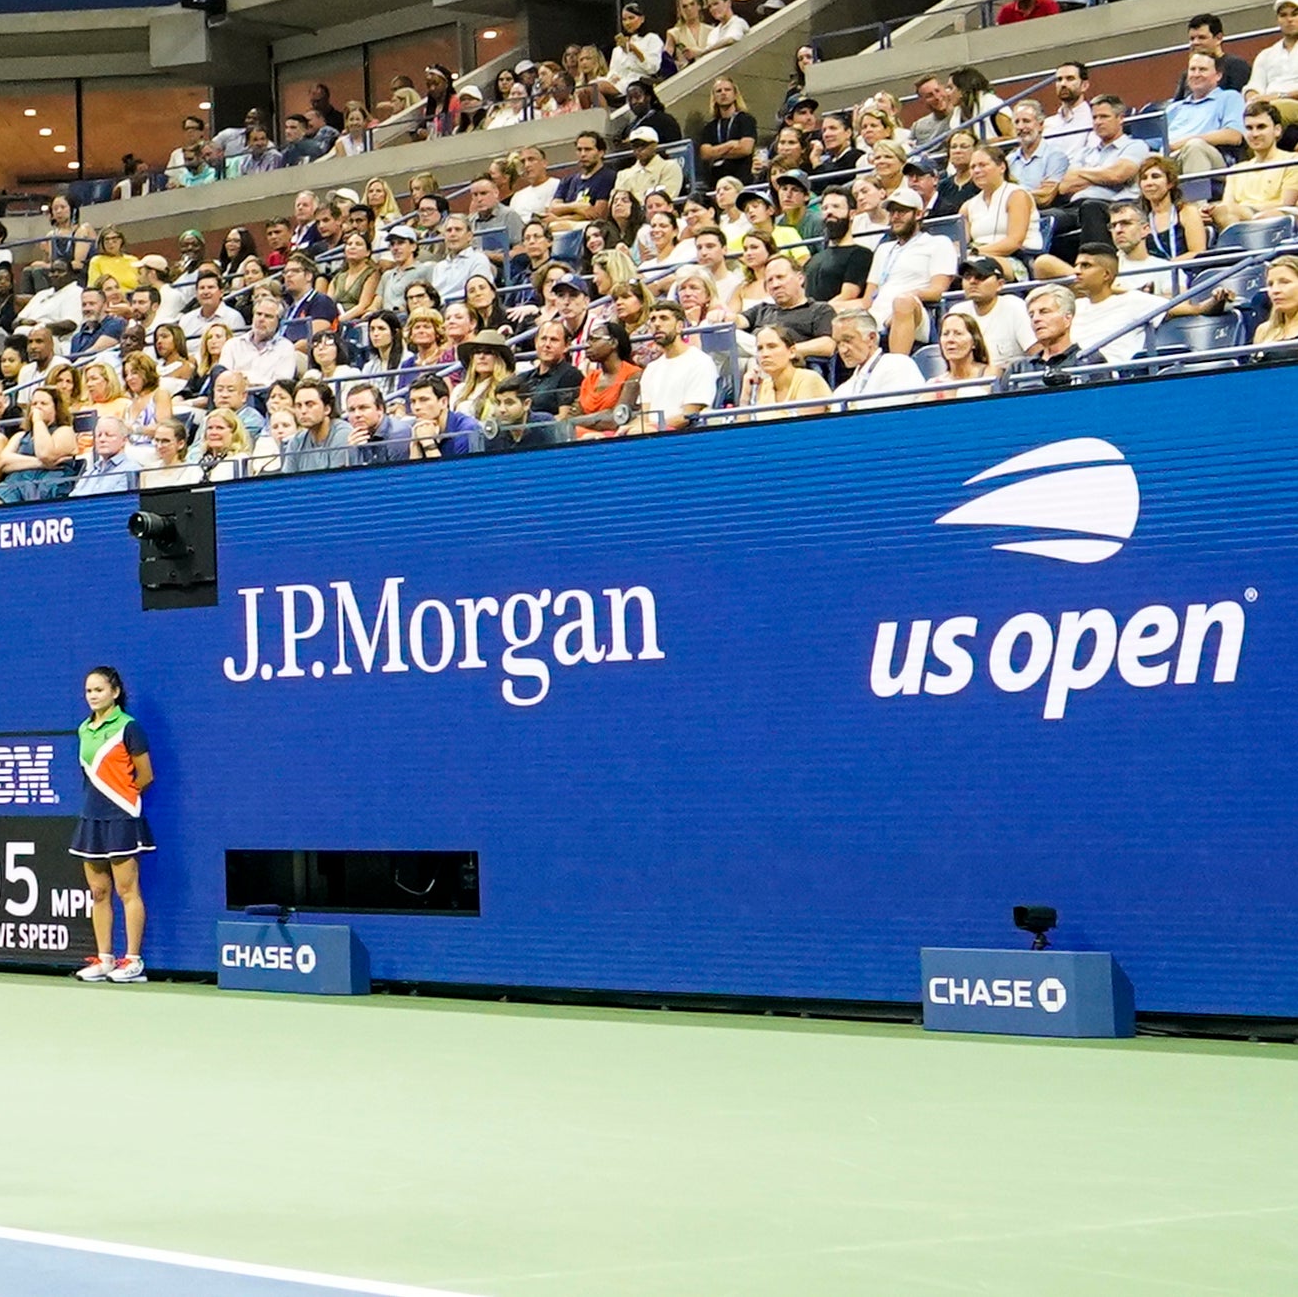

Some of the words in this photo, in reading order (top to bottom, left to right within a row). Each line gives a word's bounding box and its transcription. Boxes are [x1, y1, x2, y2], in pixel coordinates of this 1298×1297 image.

[869, 616, 978, 698] us
[988, 599, 1247, 720] open
[18, 922, 69, 951] SPEED
[221, 944, 294, 970] CHASE
[928, 977, 1034, 1008] CHASE
